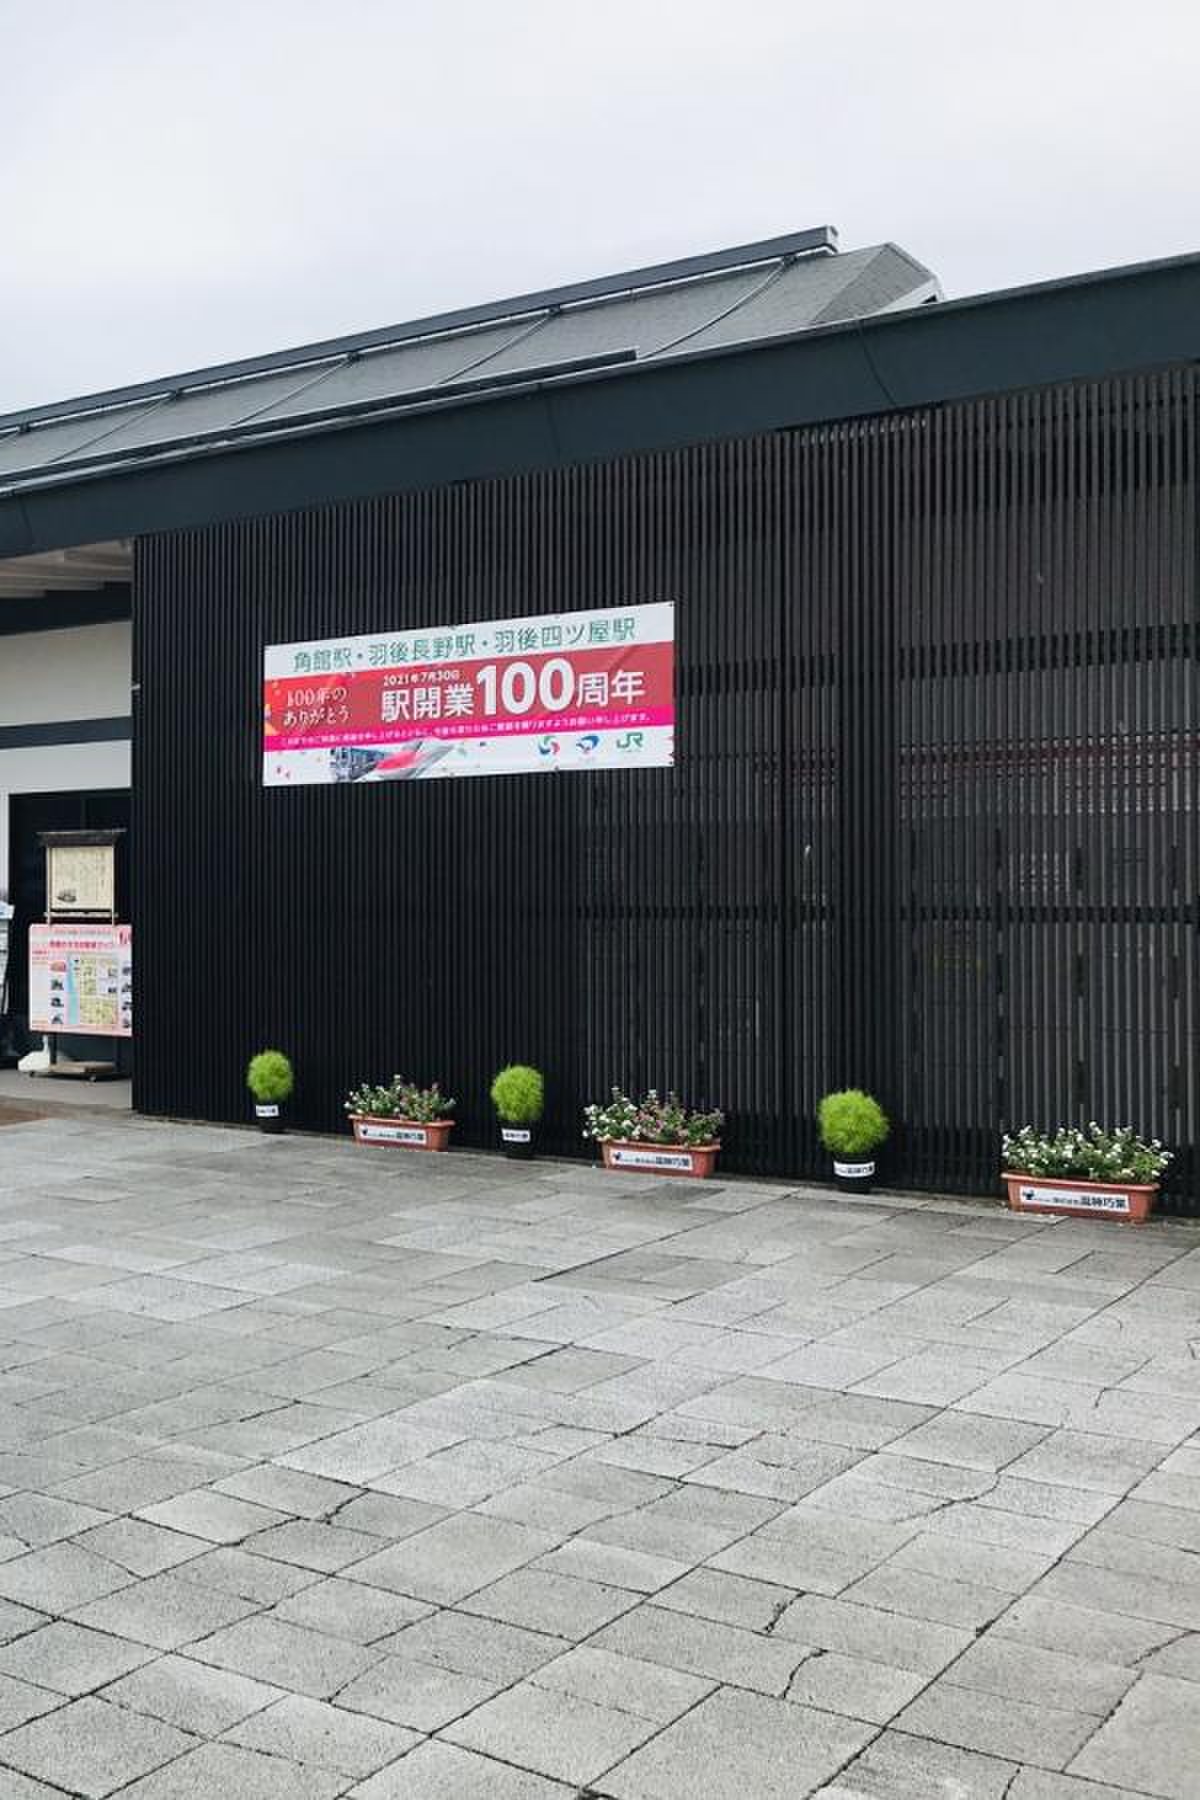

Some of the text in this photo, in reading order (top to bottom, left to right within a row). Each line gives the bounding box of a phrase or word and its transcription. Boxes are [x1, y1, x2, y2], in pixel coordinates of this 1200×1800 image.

[293, 617, 636, 672] 角館駅・羽後長野駅・羽後四ツ屋駅
[381, 657, 645, 723] 駅開業100周年
[283, 705, 350, 727] ありがとう
[616, 732, 644, 749] JR
